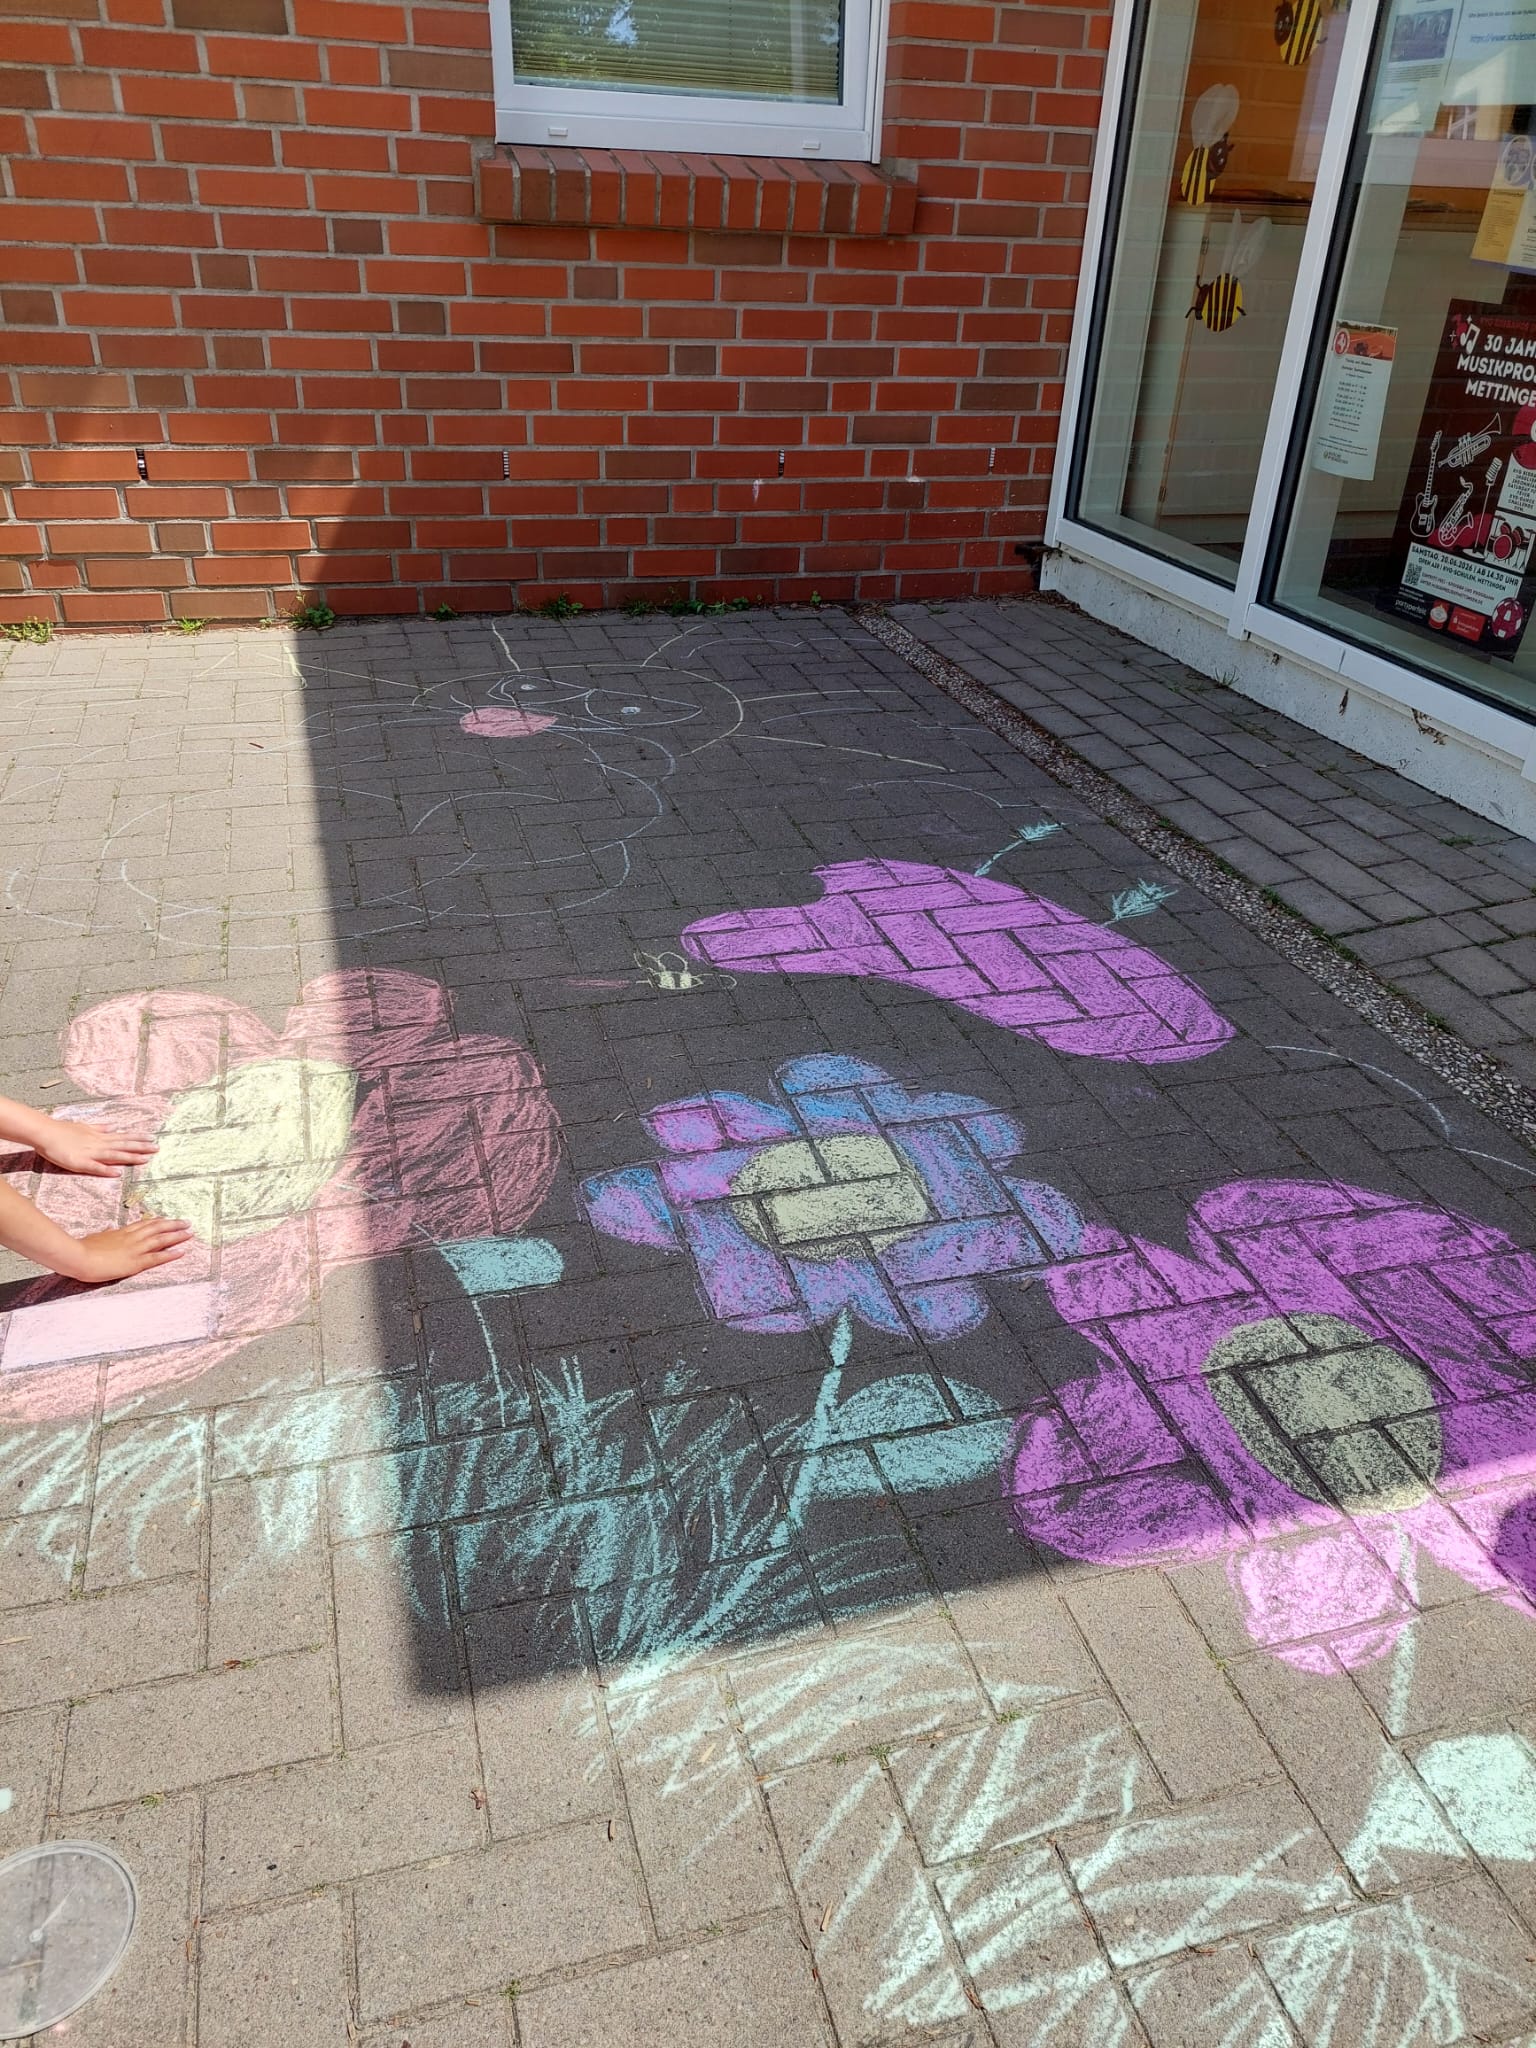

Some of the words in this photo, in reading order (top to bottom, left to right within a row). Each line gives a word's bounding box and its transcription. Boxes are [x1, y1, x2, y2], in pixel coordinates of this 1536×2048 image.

[1484, 334, 1503, 352] 30
[1504, 337, 1536, 359] JAH
[1505, 575, 1519, 586] UHR
